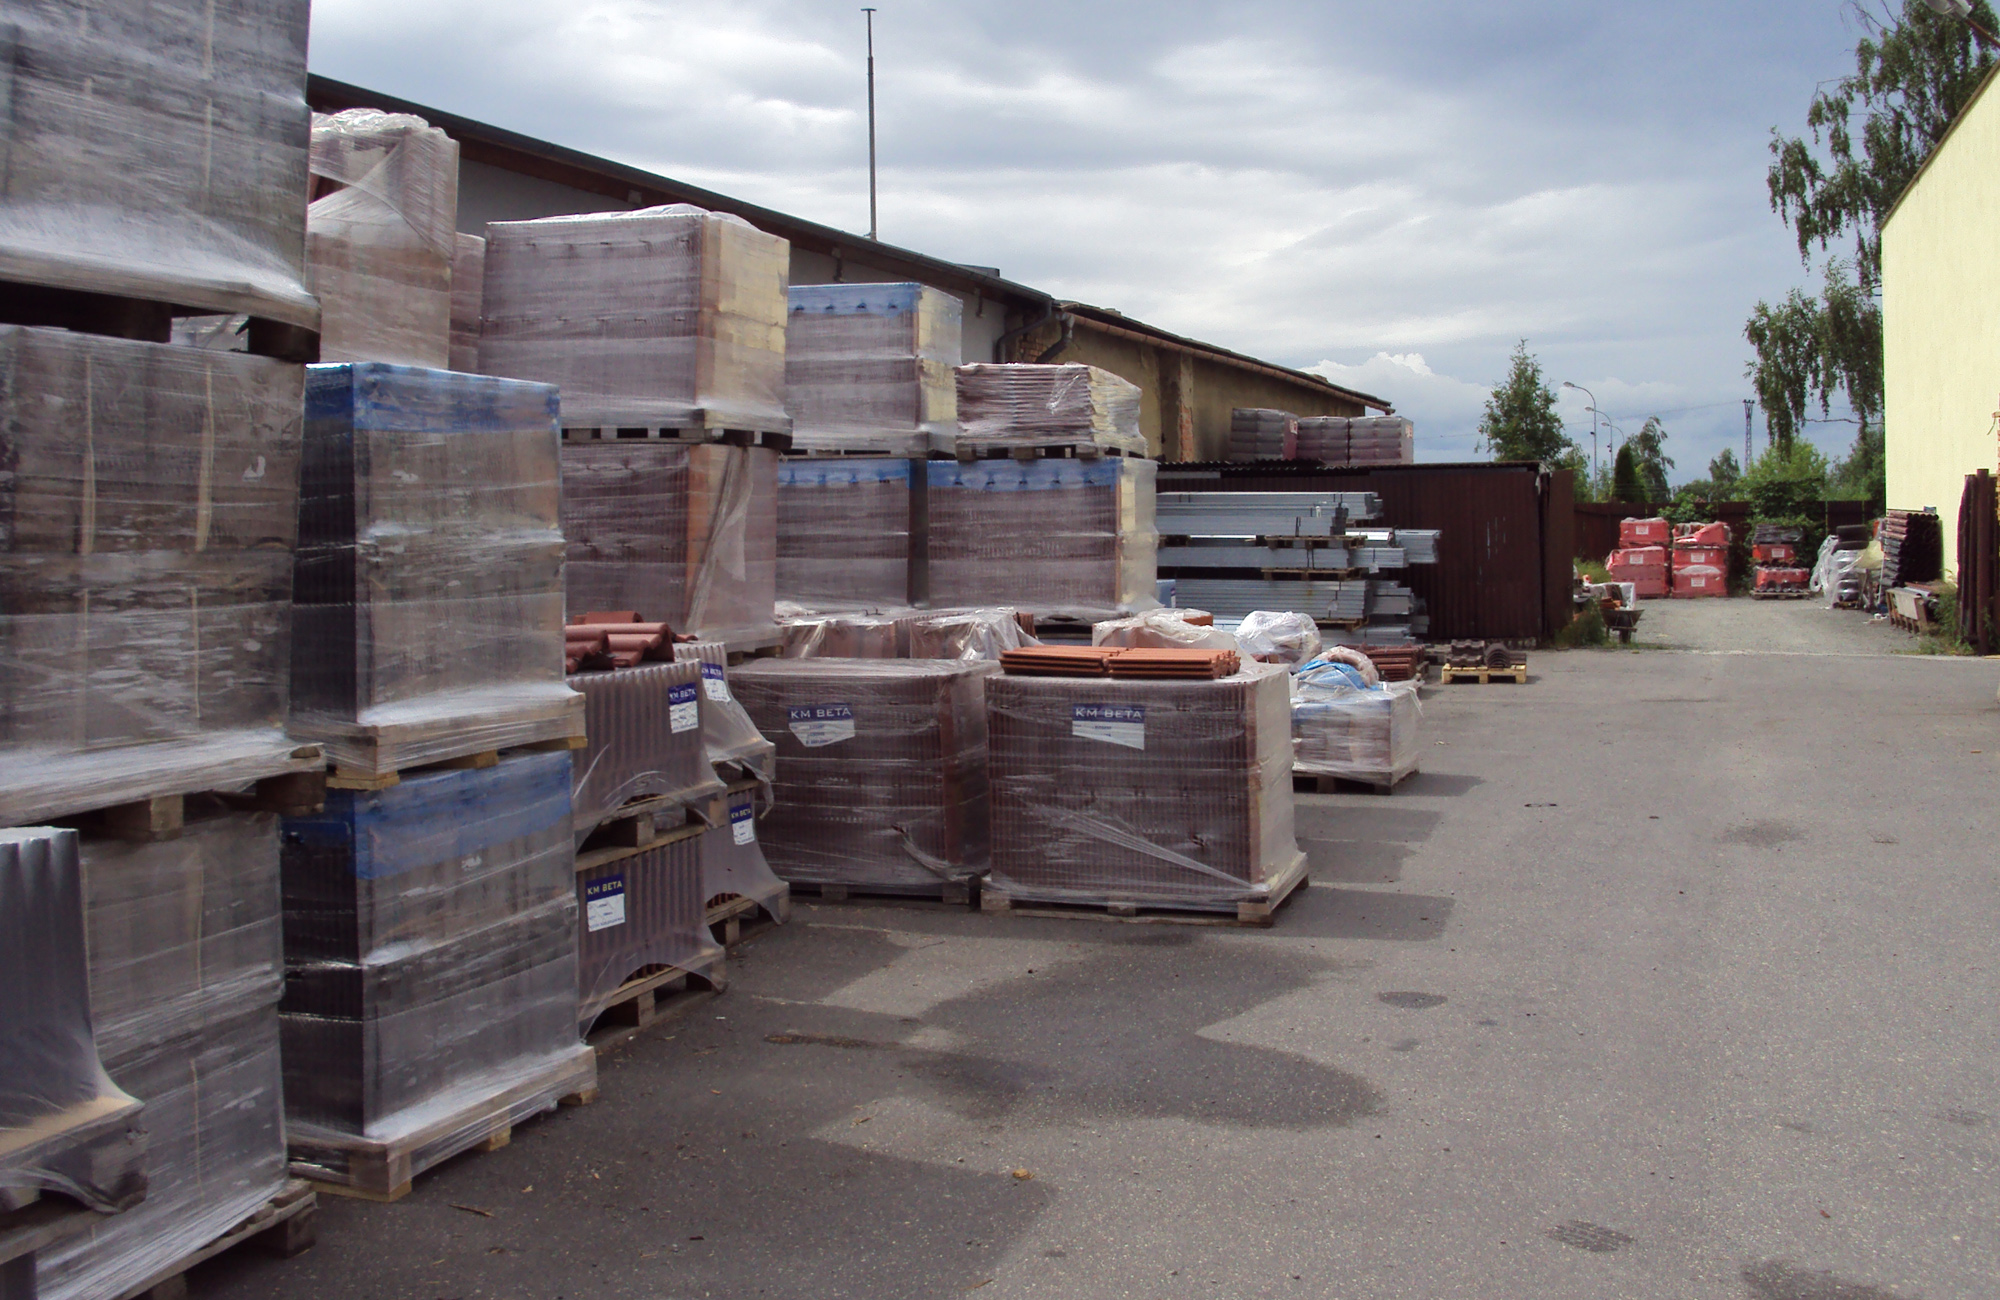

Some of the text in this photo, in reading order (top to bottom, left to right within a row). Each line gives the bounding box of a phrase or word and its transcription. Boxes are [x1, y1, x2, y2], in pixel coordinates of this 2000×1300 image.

[710, 668, 722, 676] BETA
[680, 688, 696, 698] BETA
[790, 708, 851, 719] KM BETA
[1076, 708, 1142, 720] KM BETA
[587, 881, 622, 895] KM BETA
